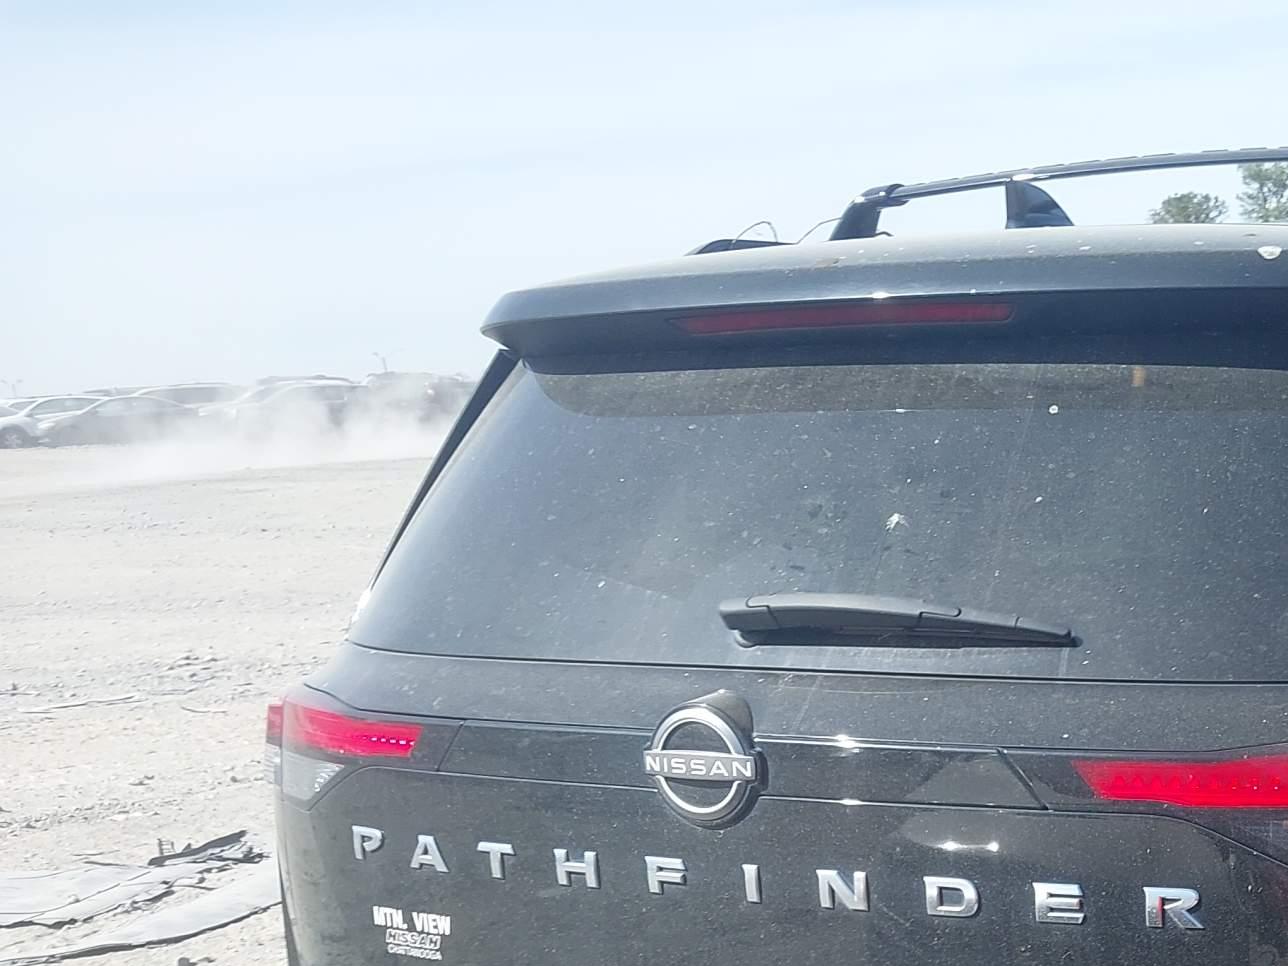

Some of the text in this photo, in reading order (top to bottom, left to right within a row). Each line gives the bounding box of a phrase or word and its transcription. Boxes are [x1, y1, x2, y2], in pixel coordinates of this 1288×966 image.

[645, 754, 753, 779] NISSAN
[352, 825, 1205, 929] PATHFINDER
[411, 911, 451, 936] VIEW
